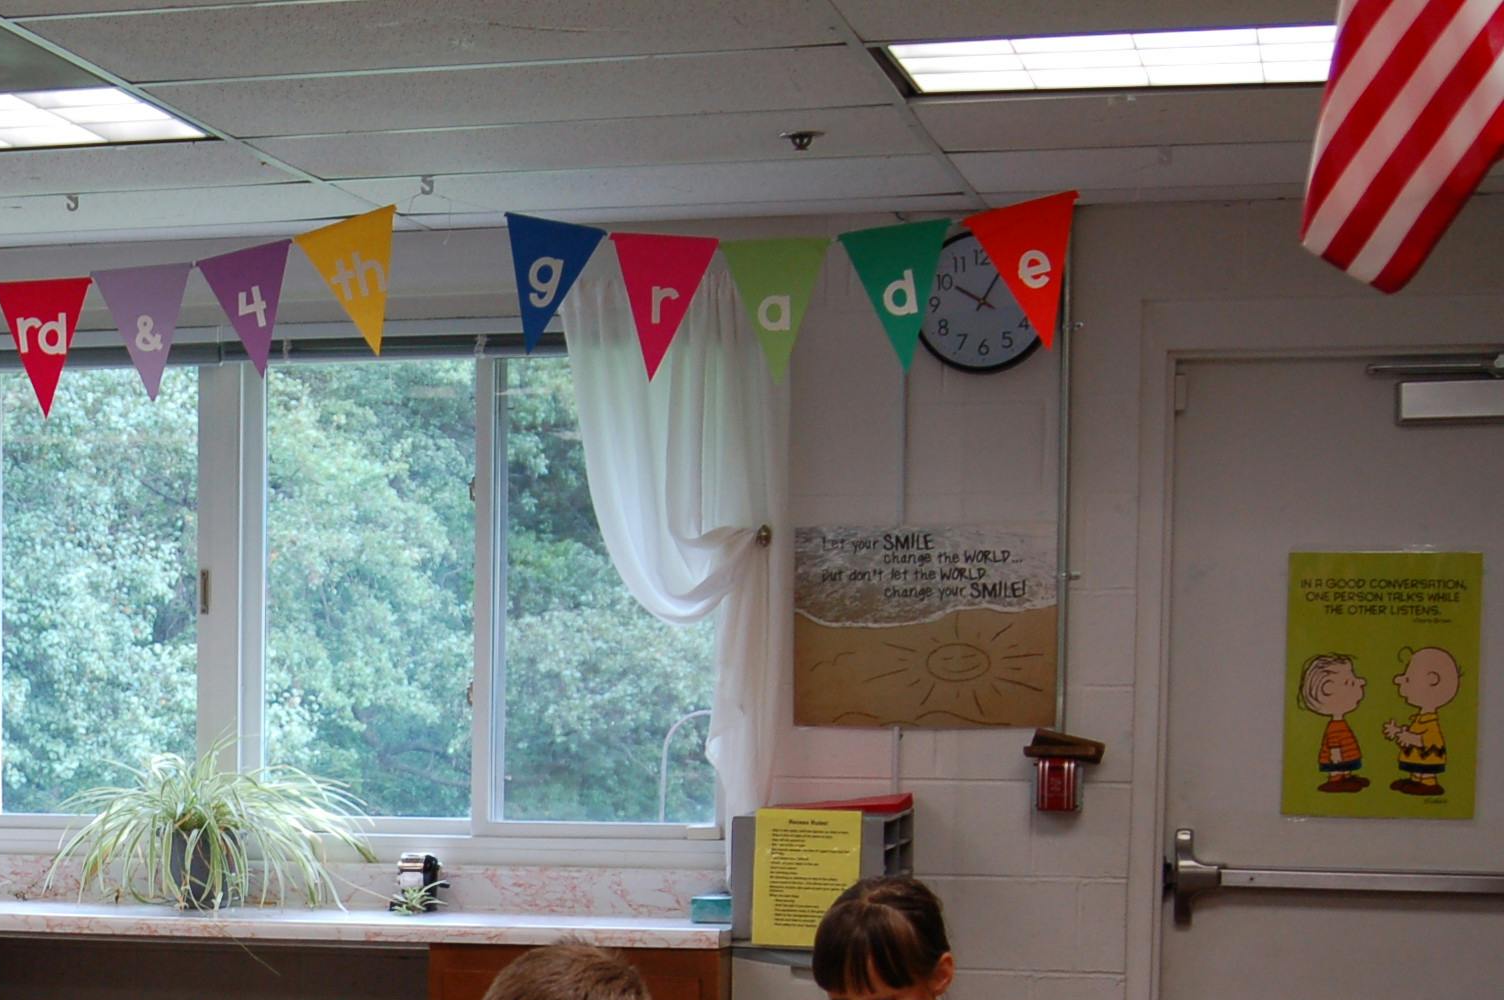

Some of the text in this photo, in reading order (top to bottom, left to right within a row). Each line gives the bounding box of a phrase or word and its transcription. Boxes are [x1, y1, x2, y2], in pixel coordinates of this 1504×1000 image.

[953, 255, 966, 273] 11
[974, 250, 991, 266] 12
[936, 273, 953, 290] 10
[133, 314, 164, 353] &
[236, 250, 386, 328] 4th
[528, 249, 1053, 332] grade
[928, 296, 940, 313] 9
[937, 318, 949, 336] 8
[1018, 315, 1030, 330] 4
[956, 333, 968, 350] 7
[978, 339, 990, 356] 6
[1001, 331, 1013, 348] 5
[822, 533, 935, 553] Let your SMILE
[884, 552, 931, 567] change
[938, 551, 960, 564] the
[848, 567, 884, 582] don't
[890, 568, 908, 580] let
[914, 567, 937, 580] the
[940, 568, 986, 581] WORLD
[884, 580, 1027, 601] change your SMILE!
[1301, 579, 1311, 589] IN
[1315, 579, 1322, 589] A
[1325, 579, 1366, 589] GOOD
[1305, 591, 1460, 602] ONE PERSON TALKS WHILE
[1325, 604, 1343, 615] THE
[1347, 604, 1387, 615] OTHER
